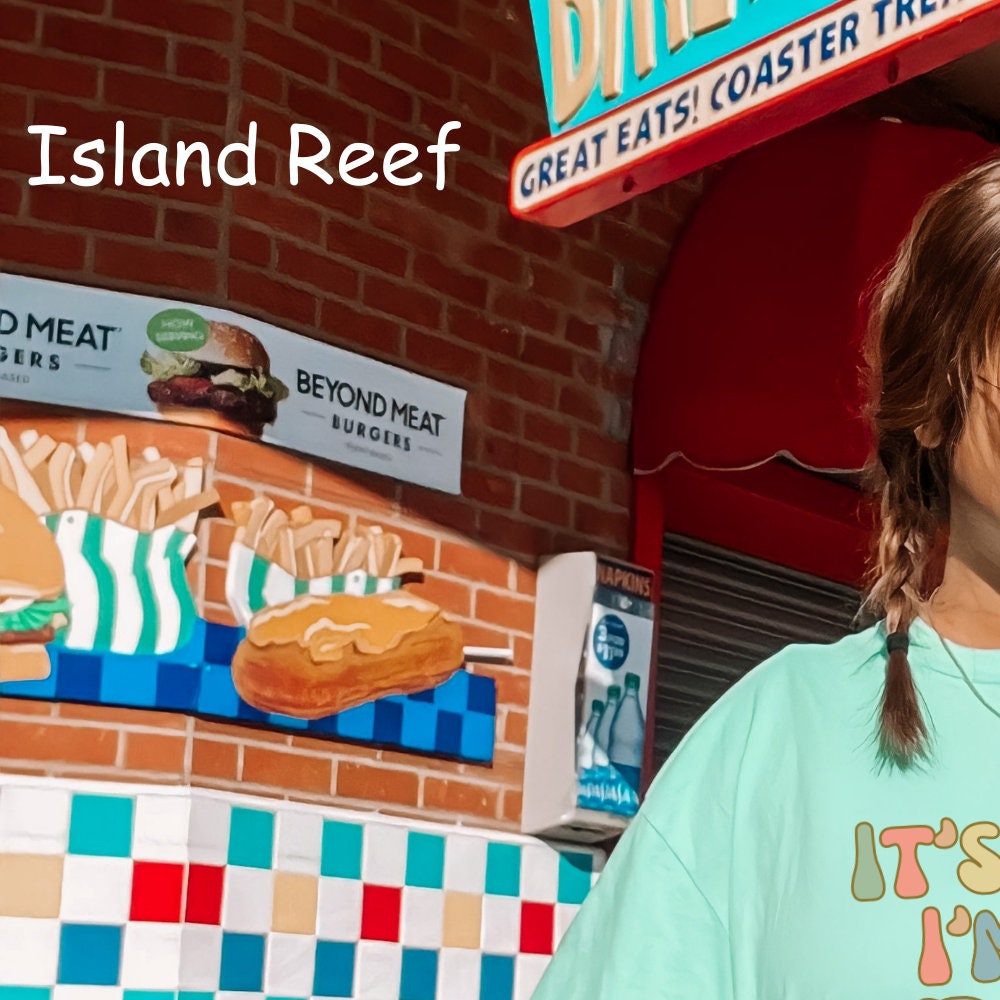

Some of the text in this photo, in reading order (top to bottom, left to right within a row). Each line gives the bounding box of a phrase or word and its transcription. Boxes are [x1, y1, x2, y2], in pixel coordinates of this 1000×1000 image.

[520, 129, 609, 198] GREAT
[617, 86, 699, 157] EATS!
[711, 12, 860, 111] COASTER
[26, 312, 118, 351] MEAT
[297, 368, 447, 437] BEYOND MEAT
[331, 413, 412, 452] BURGERS
